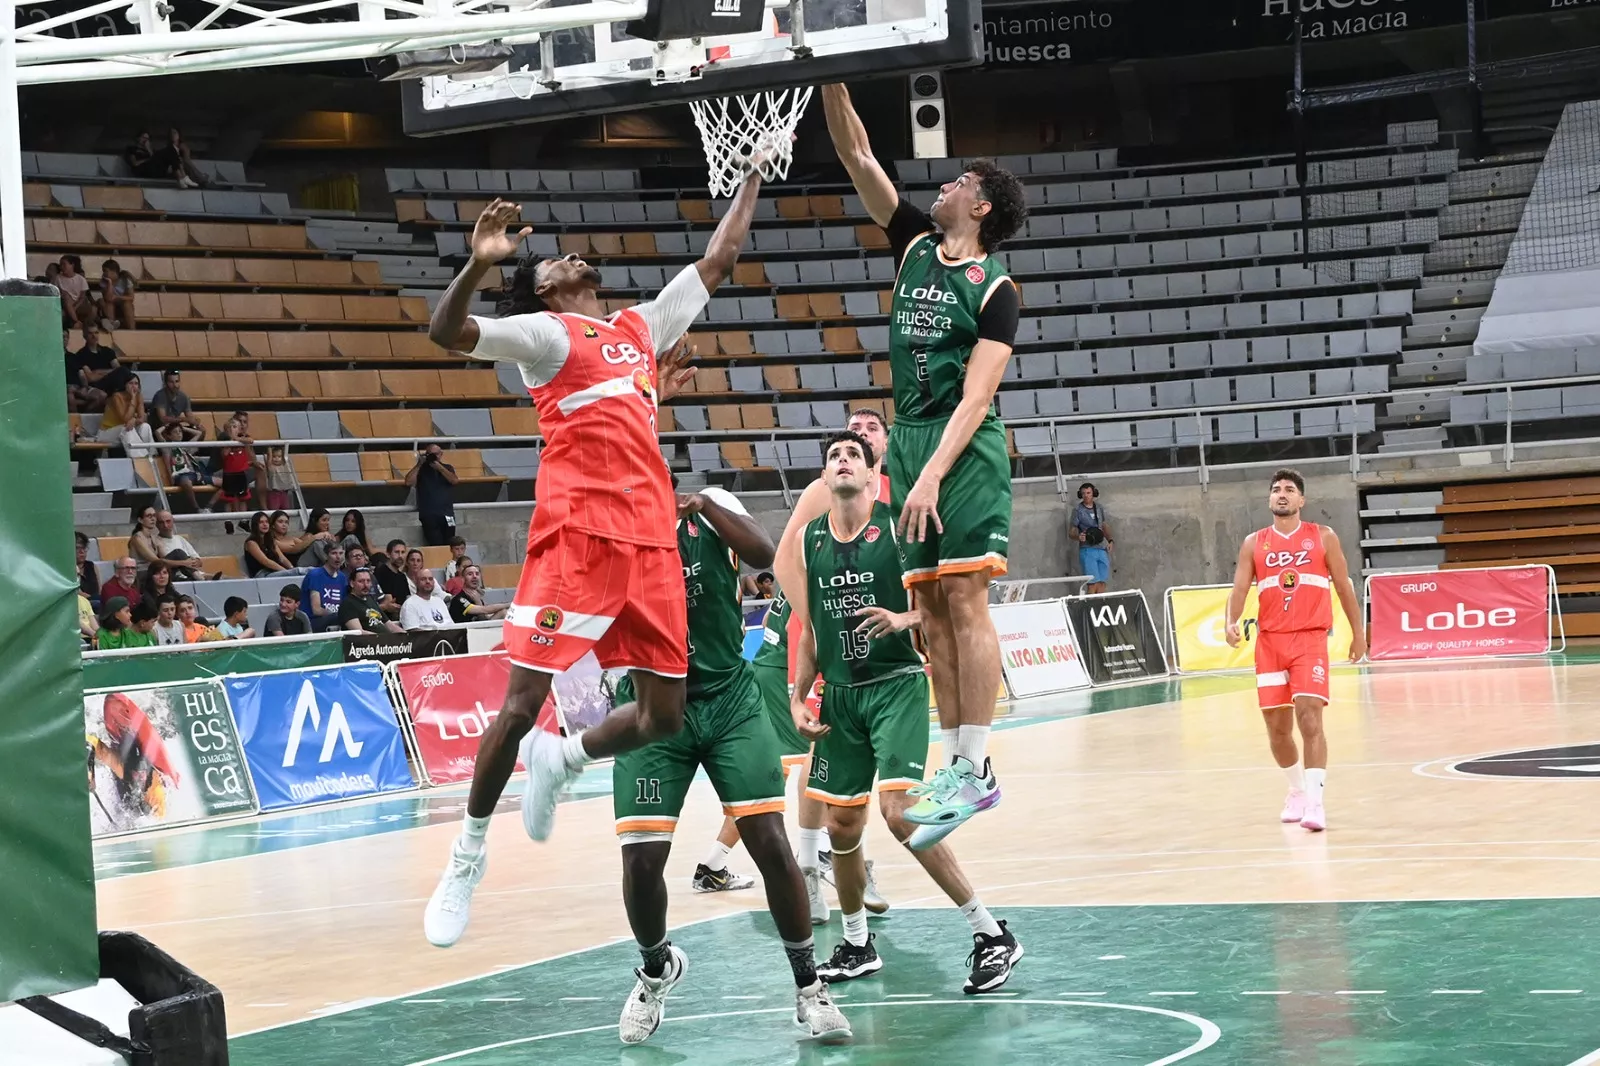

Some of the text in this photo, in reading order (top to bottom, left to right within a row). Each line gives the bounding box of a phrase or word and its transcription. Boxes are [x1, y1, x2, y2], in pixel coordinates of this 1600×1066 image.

[899, 283, 959, 304] Lobe
[896, 310, 953, 330] Huesca
[1264, 550, 1312, 568] CBZ
[818, 570, 875, 589] Lobe
[1400, 582, 1437, 594] GRUPO
[822, 593, 877, 611] Huesca
[1283, 596, 1293, 611] 7
[1401, 602, 1517, 632] Lobe
[349, 642, 413, 659] Ágreda Automóvil
[839, 628, 870, 661] 15
[1412, 637, 1506, 651] HIGH QUALITY HOMES
[421, 671, 455, 688] GRUPO
[809, 755, 829, 782] 15
[635, 777, 662, 804] 11
